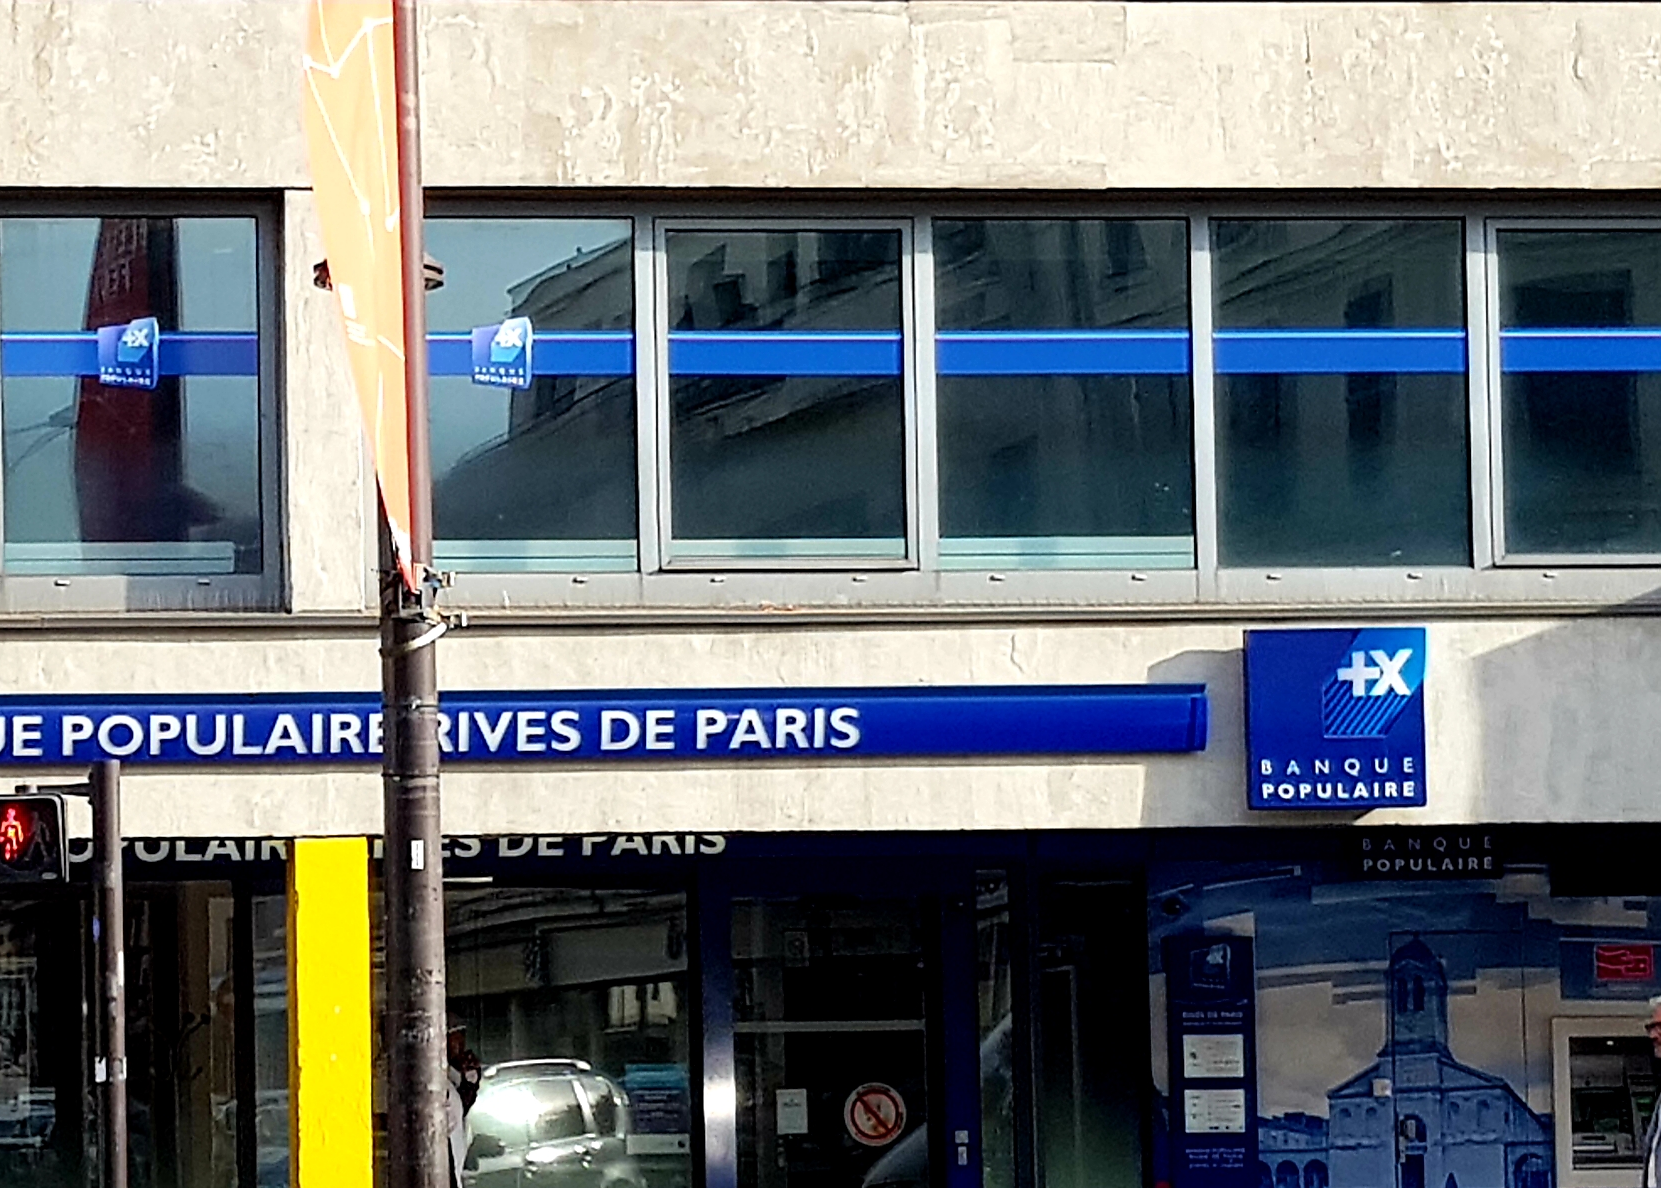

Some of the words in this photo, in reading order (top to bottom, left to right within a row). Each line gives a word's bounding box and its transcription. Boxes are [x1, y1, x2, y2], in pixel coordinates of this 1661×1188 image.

[600, 708, 675, 751] DE
[696, 706, 861, 750] PARIS
[1261, 757, 1414, 777] BANQUE
[1262, 781, 1415, 799] POPULAIRE
[1362, 836, 1492, 852] BANQUE
[1363, 856, 1492, 872] POPULAIRE
